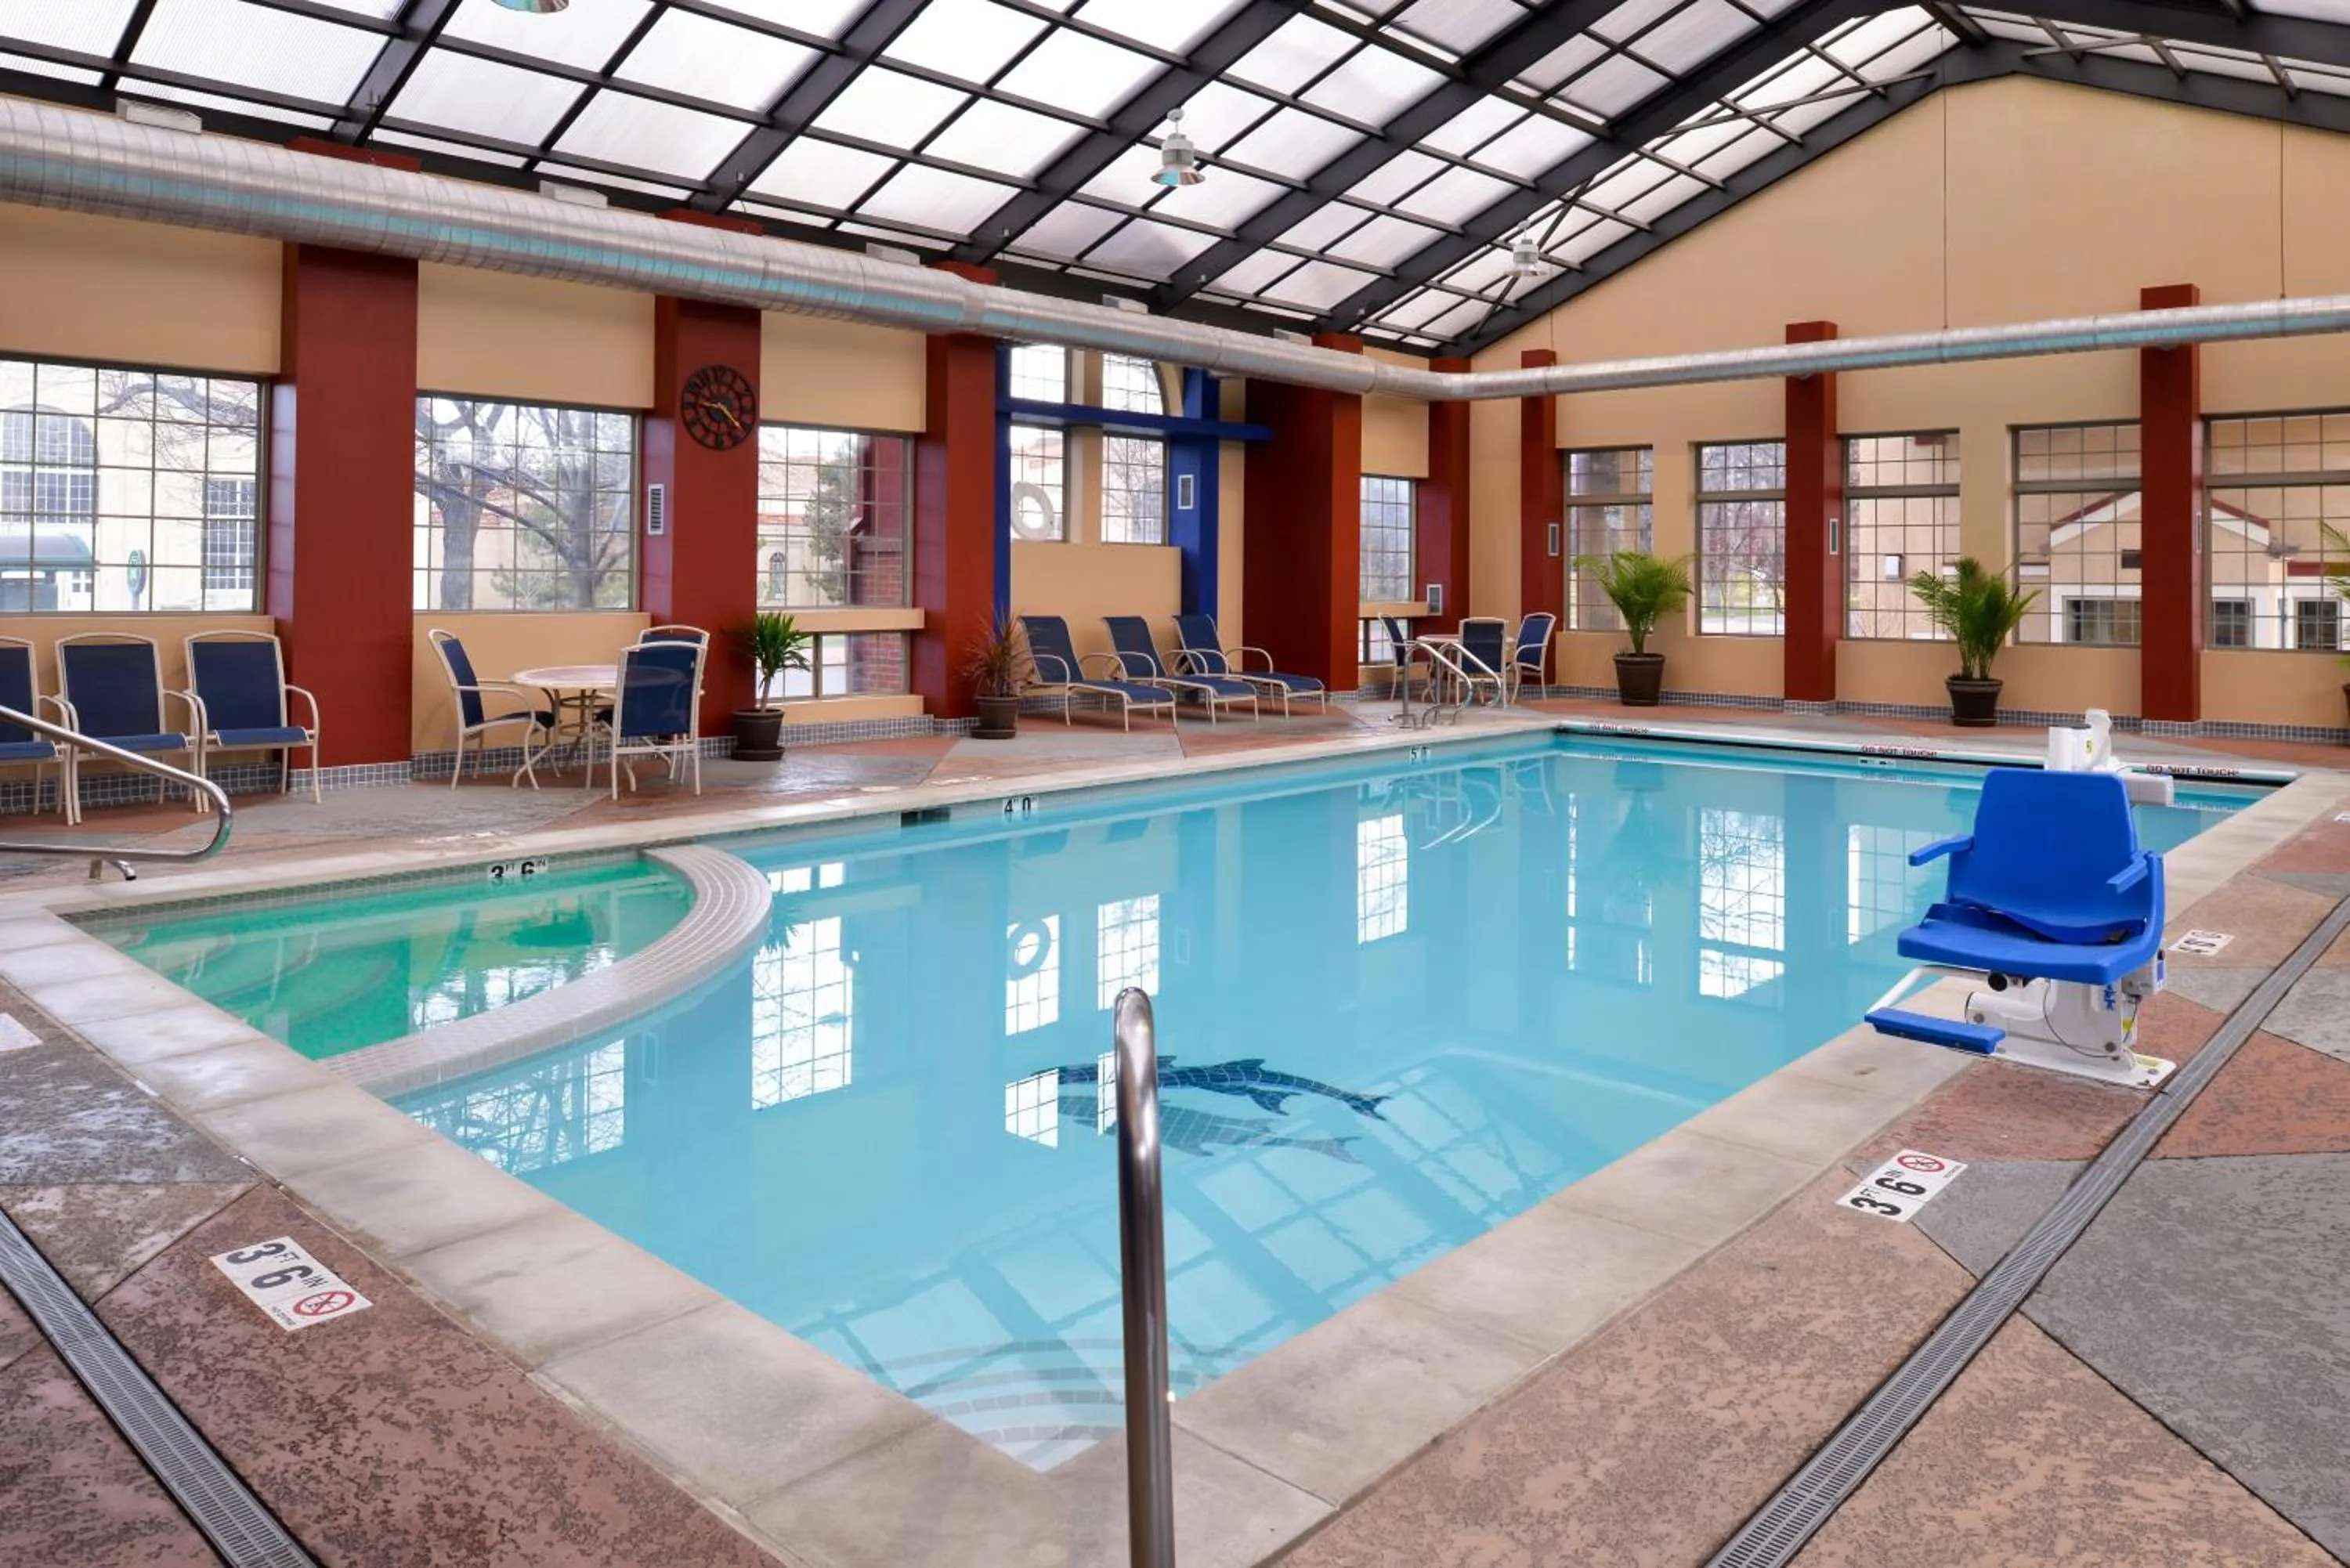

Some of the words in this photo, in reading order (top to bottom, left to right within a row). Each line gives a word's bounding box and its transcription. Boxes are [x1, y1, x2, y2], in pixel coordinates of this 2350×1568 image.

[1004, 799, 1013, 812] 4
[491, 865, 504, 878] 3
[521, 861, 535, 875] 6
[1875, 1177, 1927, 1195] 6
[1849, 1197, 1902, 1216] 3
[225, 1242, 287, 1265] 3
[250, 1264, 313, 1289] 6
